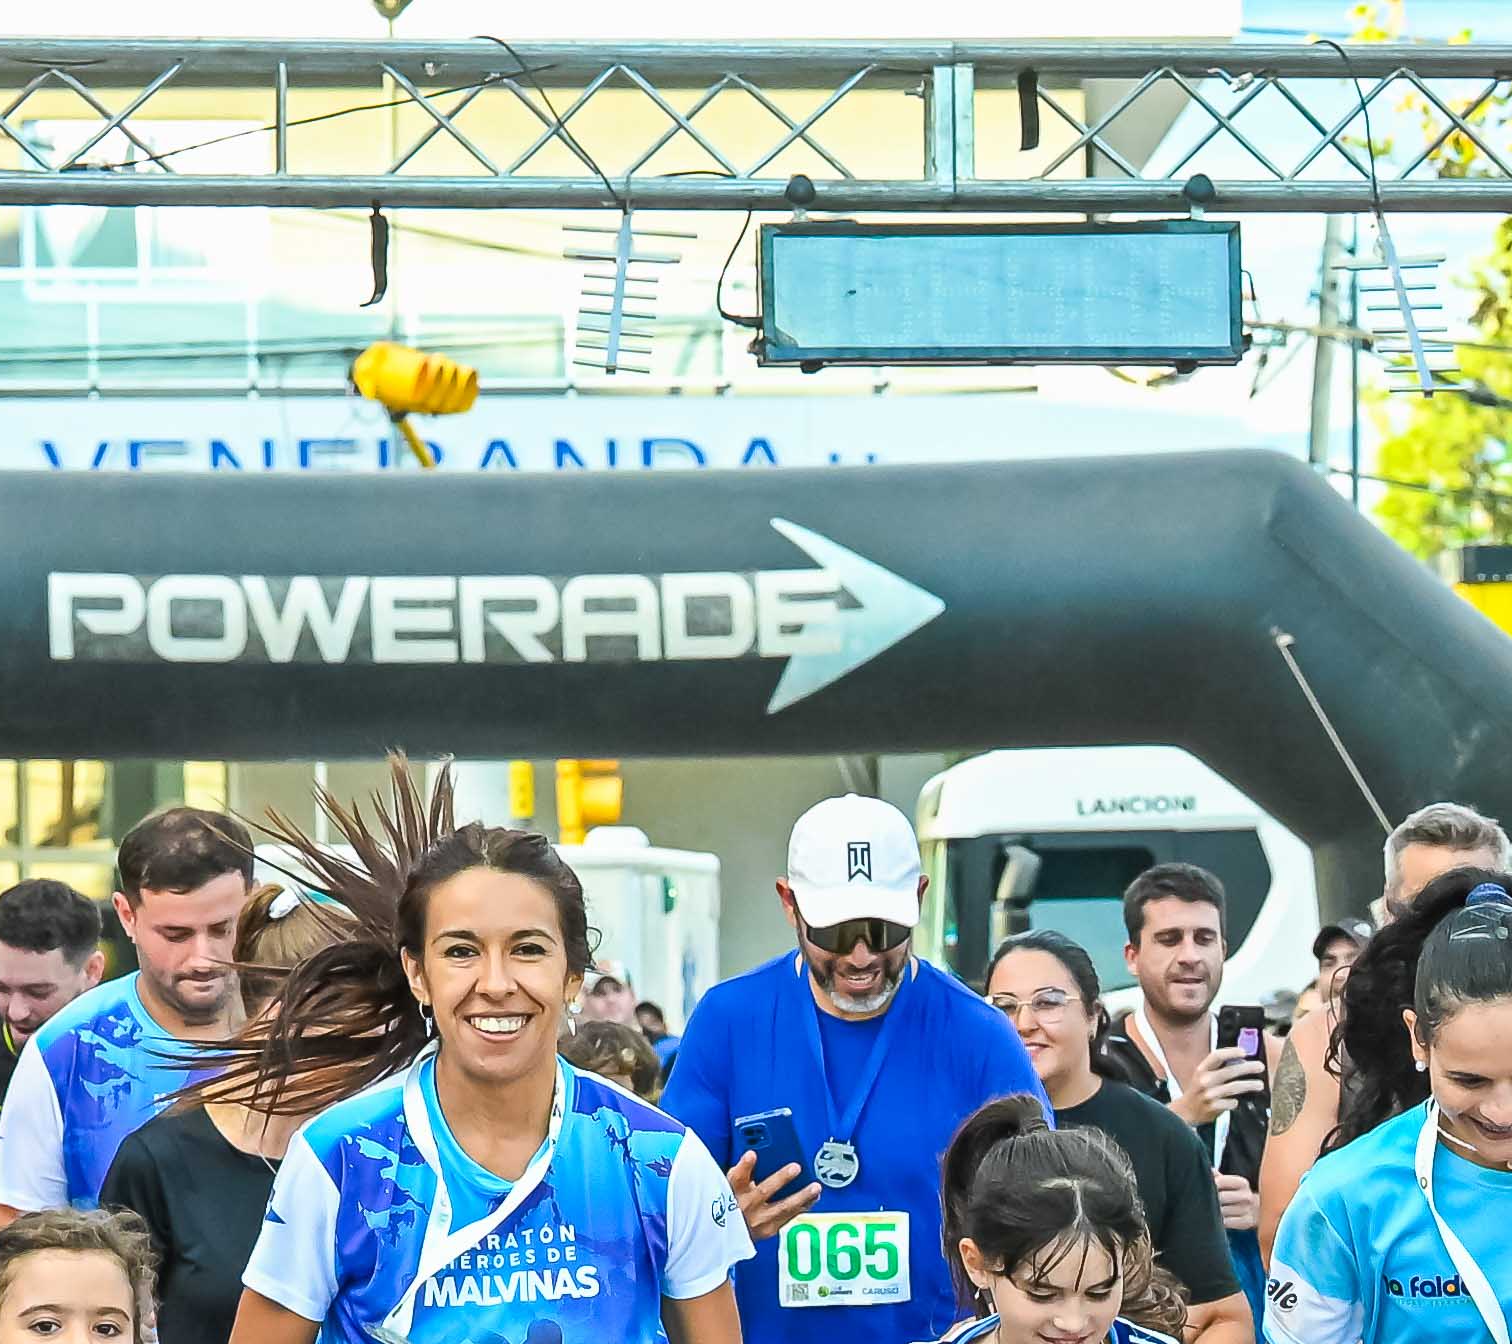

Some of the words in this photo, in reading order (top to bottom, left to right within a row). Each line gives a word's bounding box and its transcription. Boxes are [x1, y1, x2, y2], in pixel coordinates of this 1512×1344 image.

[48, 568, 842, 664] POWERADE
[471, 1223, 576, 1251] RATÓN
[547, 1245, 577, 1263] DE
[787, 1223, 899, 1281] 065
[423, 1265, 600, 1308] MALVINAS
